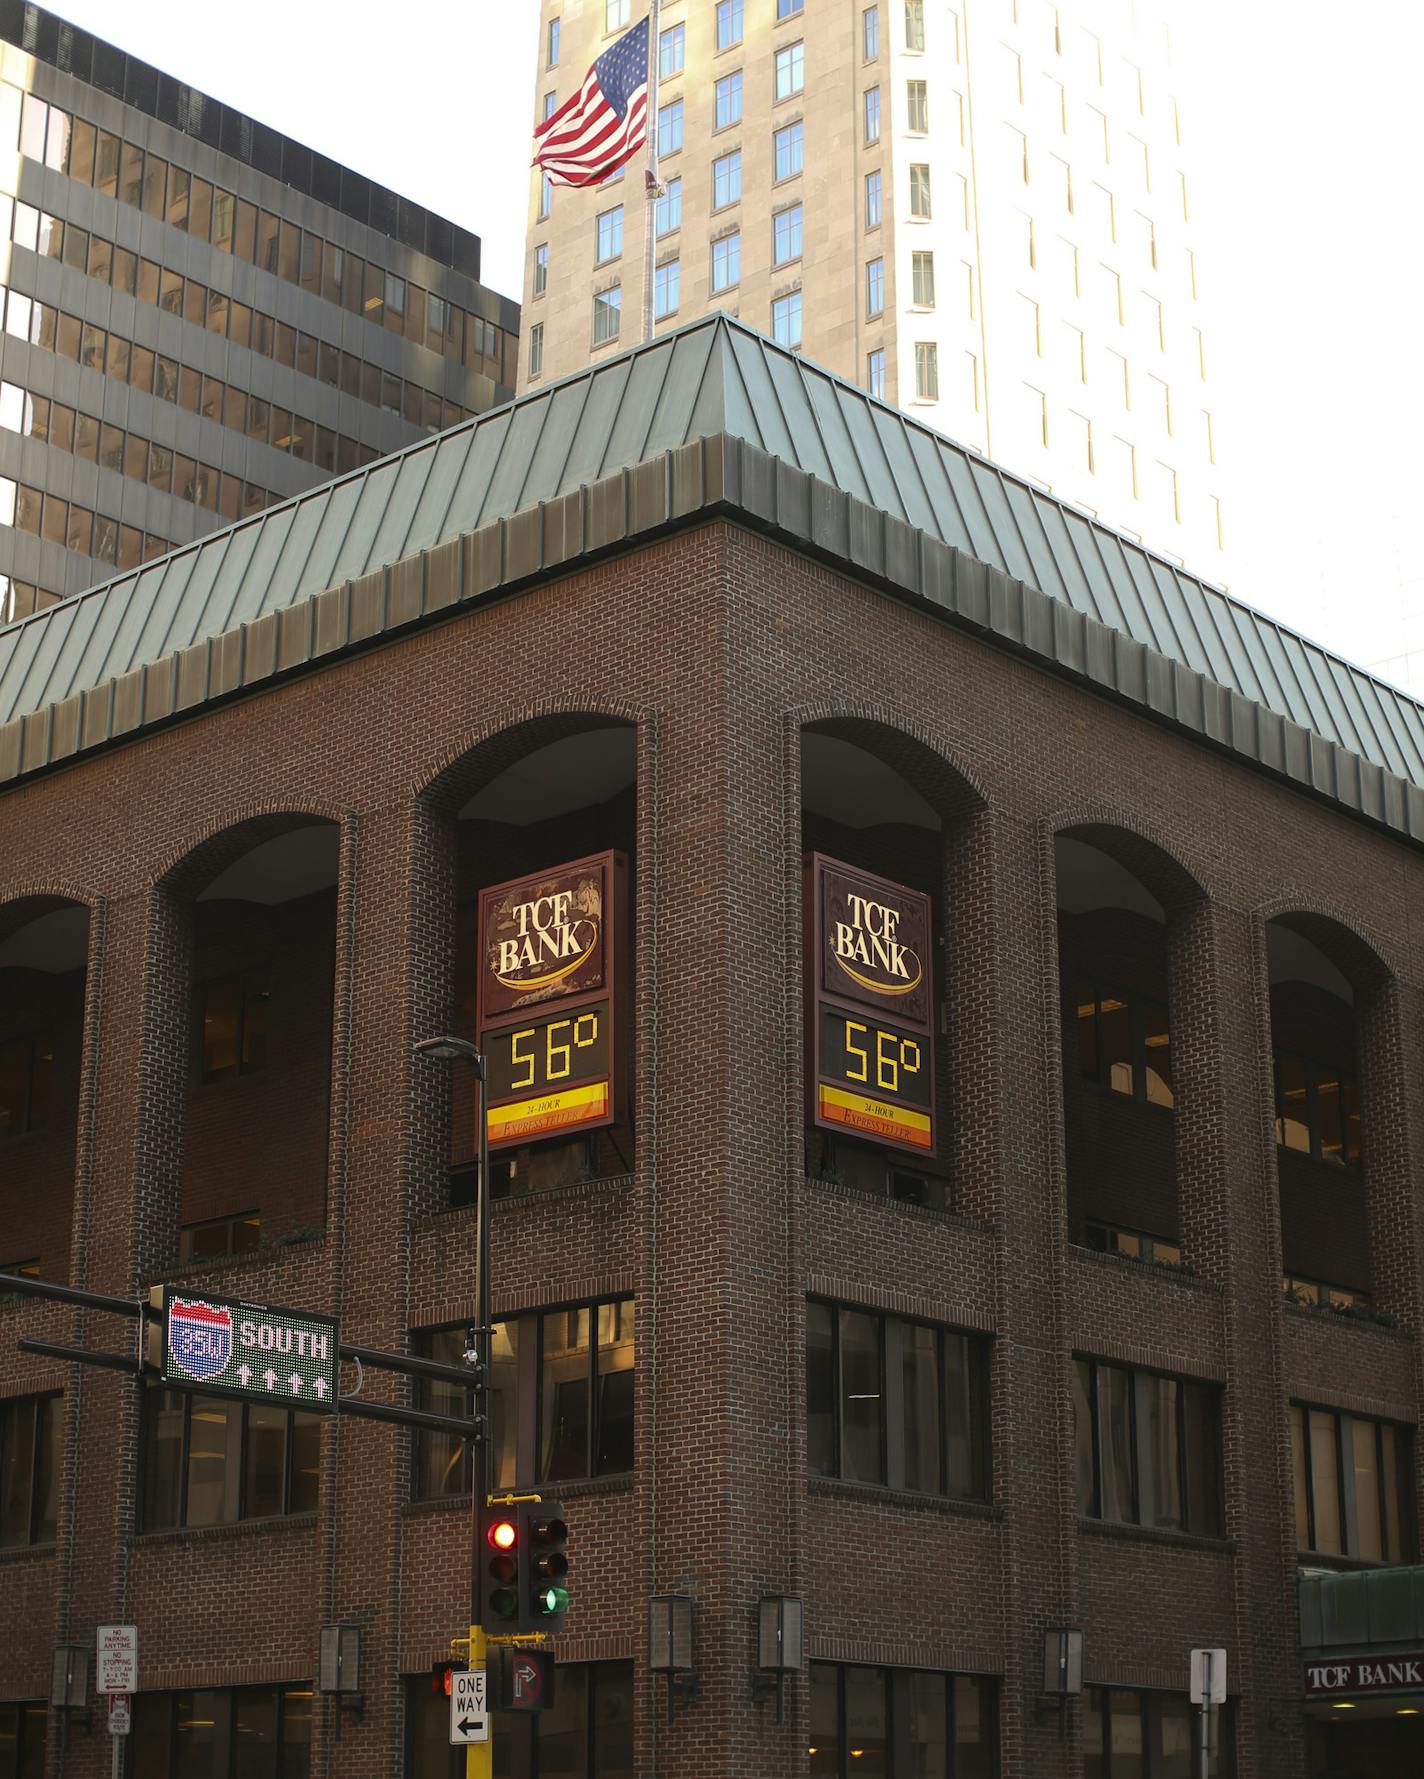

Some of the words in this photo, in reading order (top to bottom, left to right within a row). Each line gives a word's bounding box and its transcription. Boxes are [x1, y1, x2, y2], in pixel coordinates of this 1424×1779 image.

[512, 890, 573, 938] TCF
[847, 893, 899, 941] TCF
[498, 919, 584, 975] BANK
[835, 921, 911, 979] BANK
[503, 1118, 543, 1136] EXPRESS
[843, 1107, 881, 1131] EXPRESS
[239, 1318, 328, 1360] SOUTH
[457, 1677, 483, 1694] ONE
[1308, 1666, 1351, 1689] TCF
[1358, 1662, 1423, 1686] BANK
[457, 1696, 484, 1713] WAY
